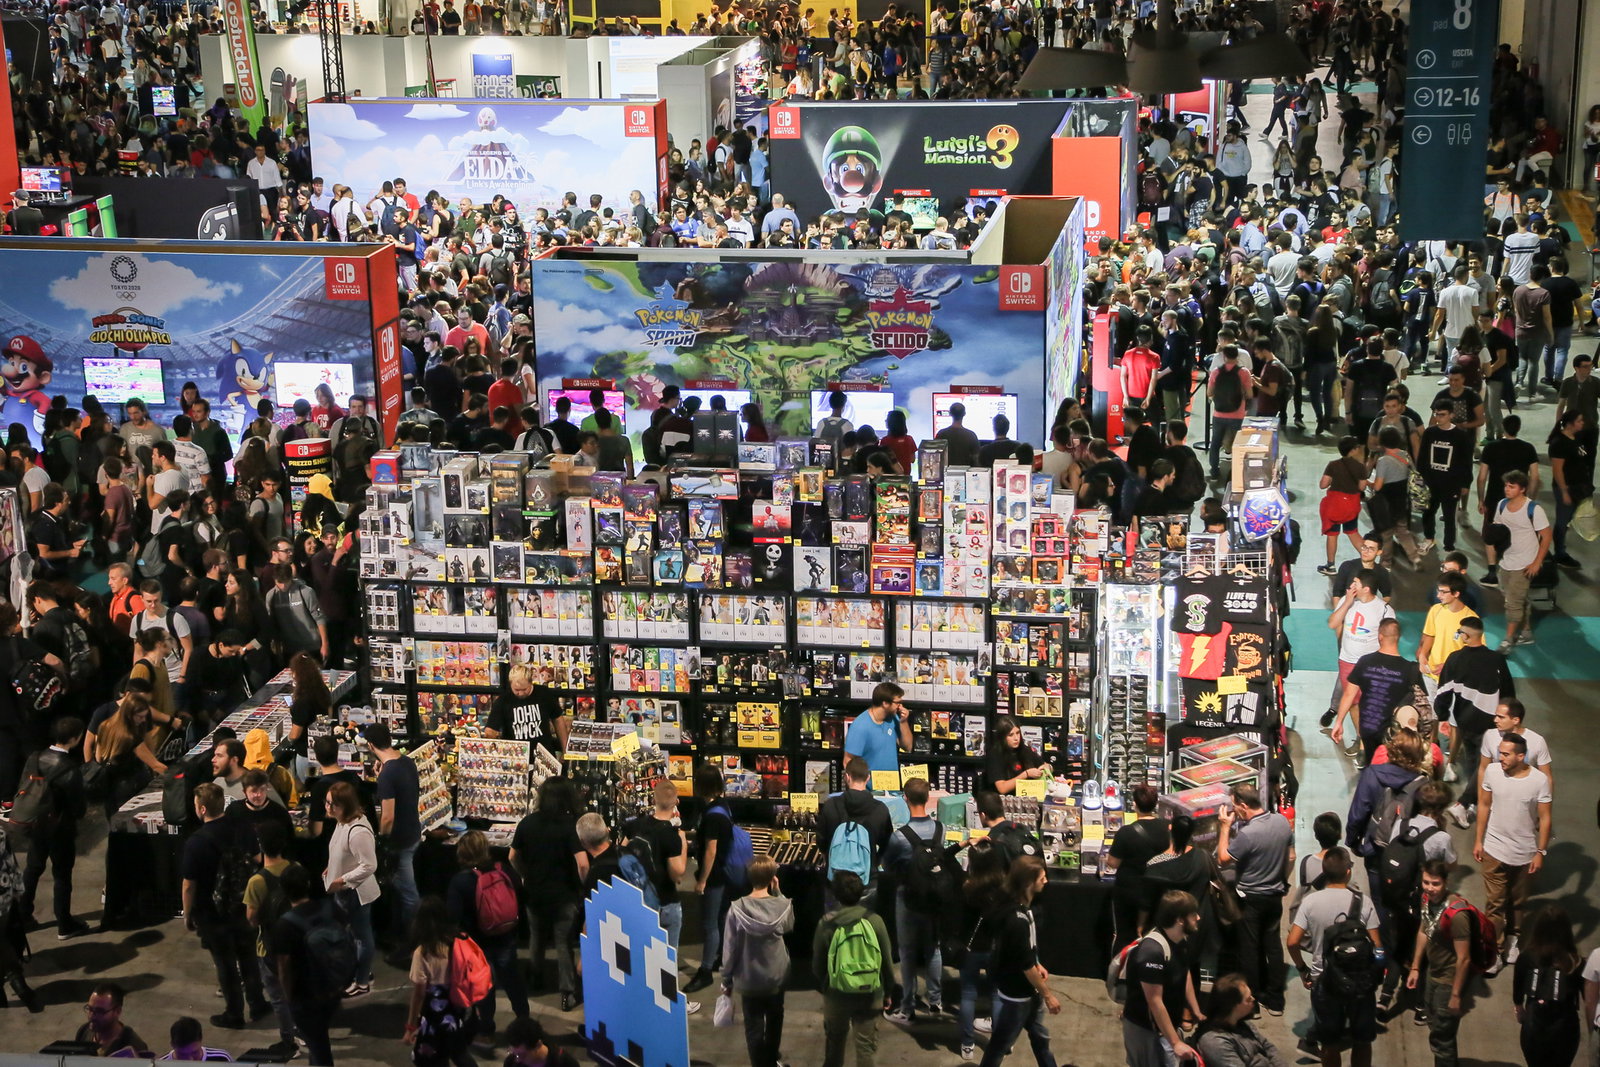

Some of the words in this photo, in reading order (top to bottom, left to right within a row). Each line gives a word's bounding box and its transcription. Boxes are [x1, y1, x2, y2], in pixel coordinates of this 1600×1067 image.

[1433, 20, 1448, 31] pad
[1453, 0, 1472, 30] 8
[1452, 49, 1473, 57] USCITA
[474, 75, 514, 86] GAMES
[474, 86, 514, 98] WEEK
[1436, 87, 1480, 107] 12-16
[924, 135, 988, 154] Luigi's
[986, 124, 1020, 169] 3
[924, 153, 987, 164] Mansion
[128, 314, 165, 329] SONIC
[89, 329, 124, 344] GIOCHI
[124, 328, 172, 345] OLIMPICI
[643, 329, 697, 347] SPADA
[870, 332, 931, 350] SCUDO
[381, 367, 400, 385] SWITCH
[289, 475, 309, 483] Game
[1229, 632, 1264, 646] Espresso
[512, 704, 541, 725] JOHN
